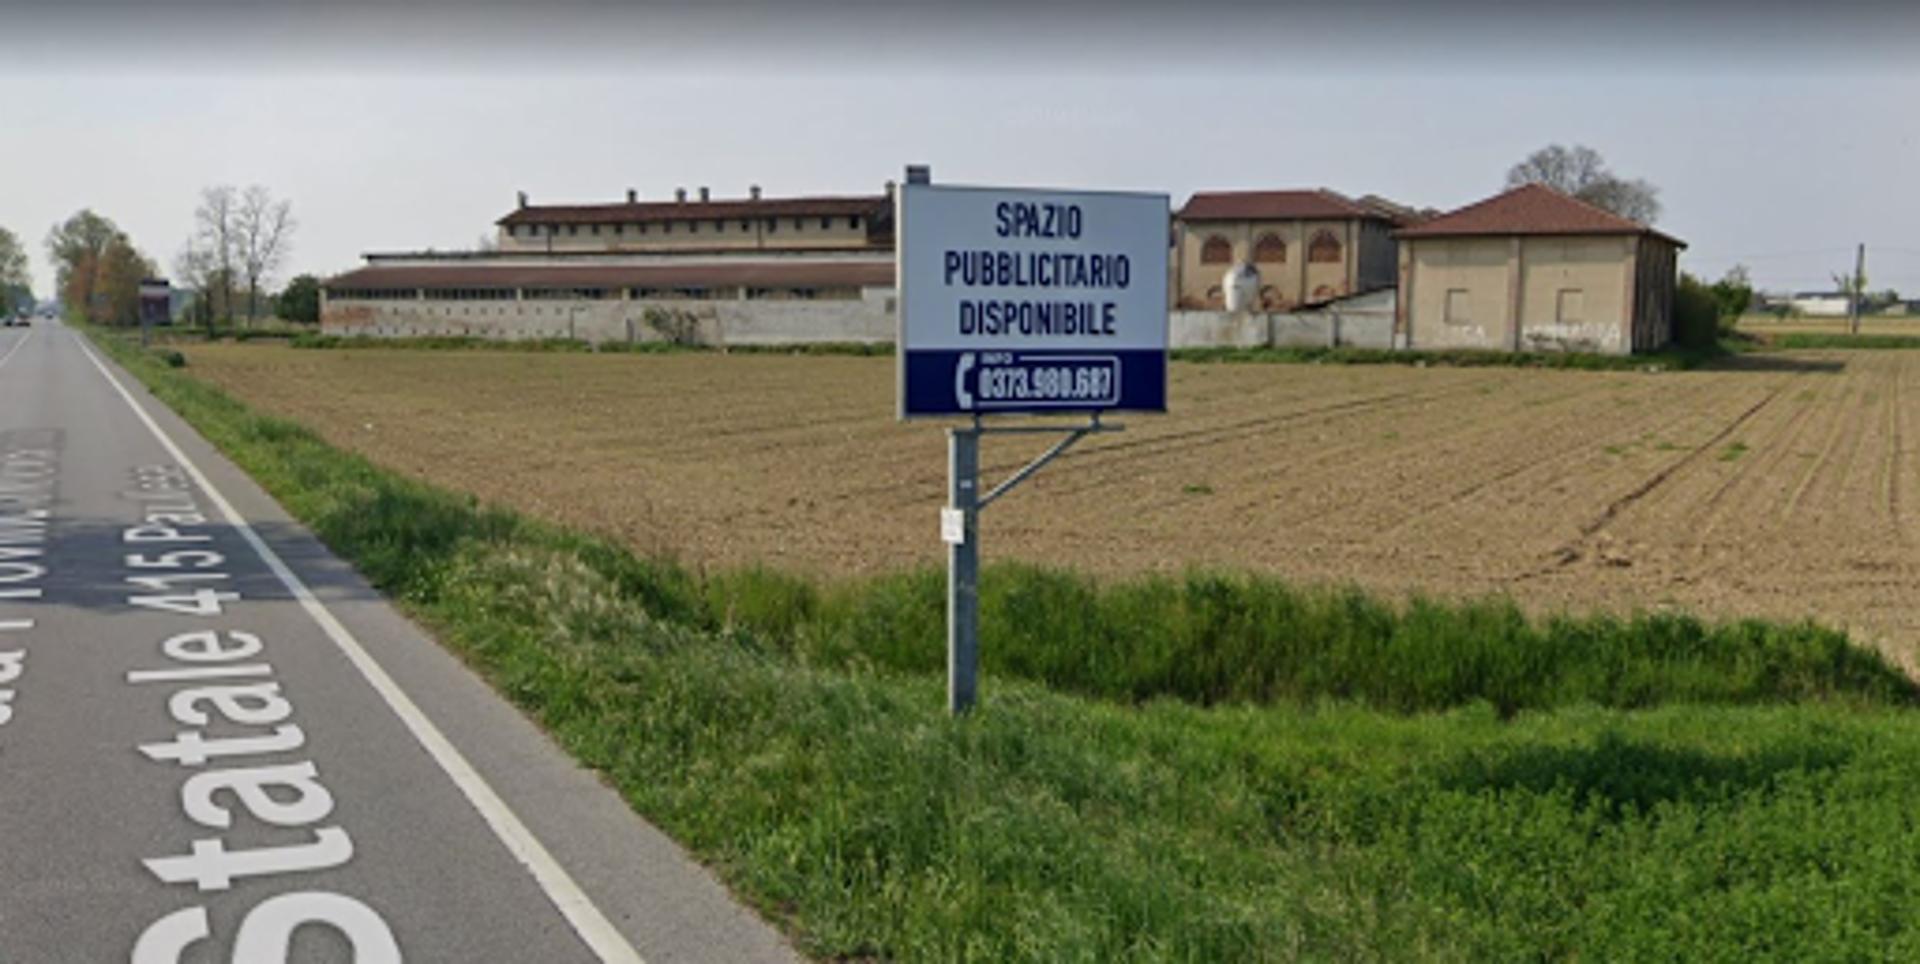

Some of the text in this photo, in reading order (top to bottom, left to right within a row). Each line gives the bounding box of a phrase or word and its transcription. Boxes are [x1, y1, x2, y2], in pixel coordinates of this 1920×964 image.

[996, 202, 1081, 238] SPAZIO
[945, 251, 1129, 288] PUBBLICITARIO
[959, 300, 1116, 335] DISPONIBILE
[978, 367, 1111, 398] 0373.980.687
